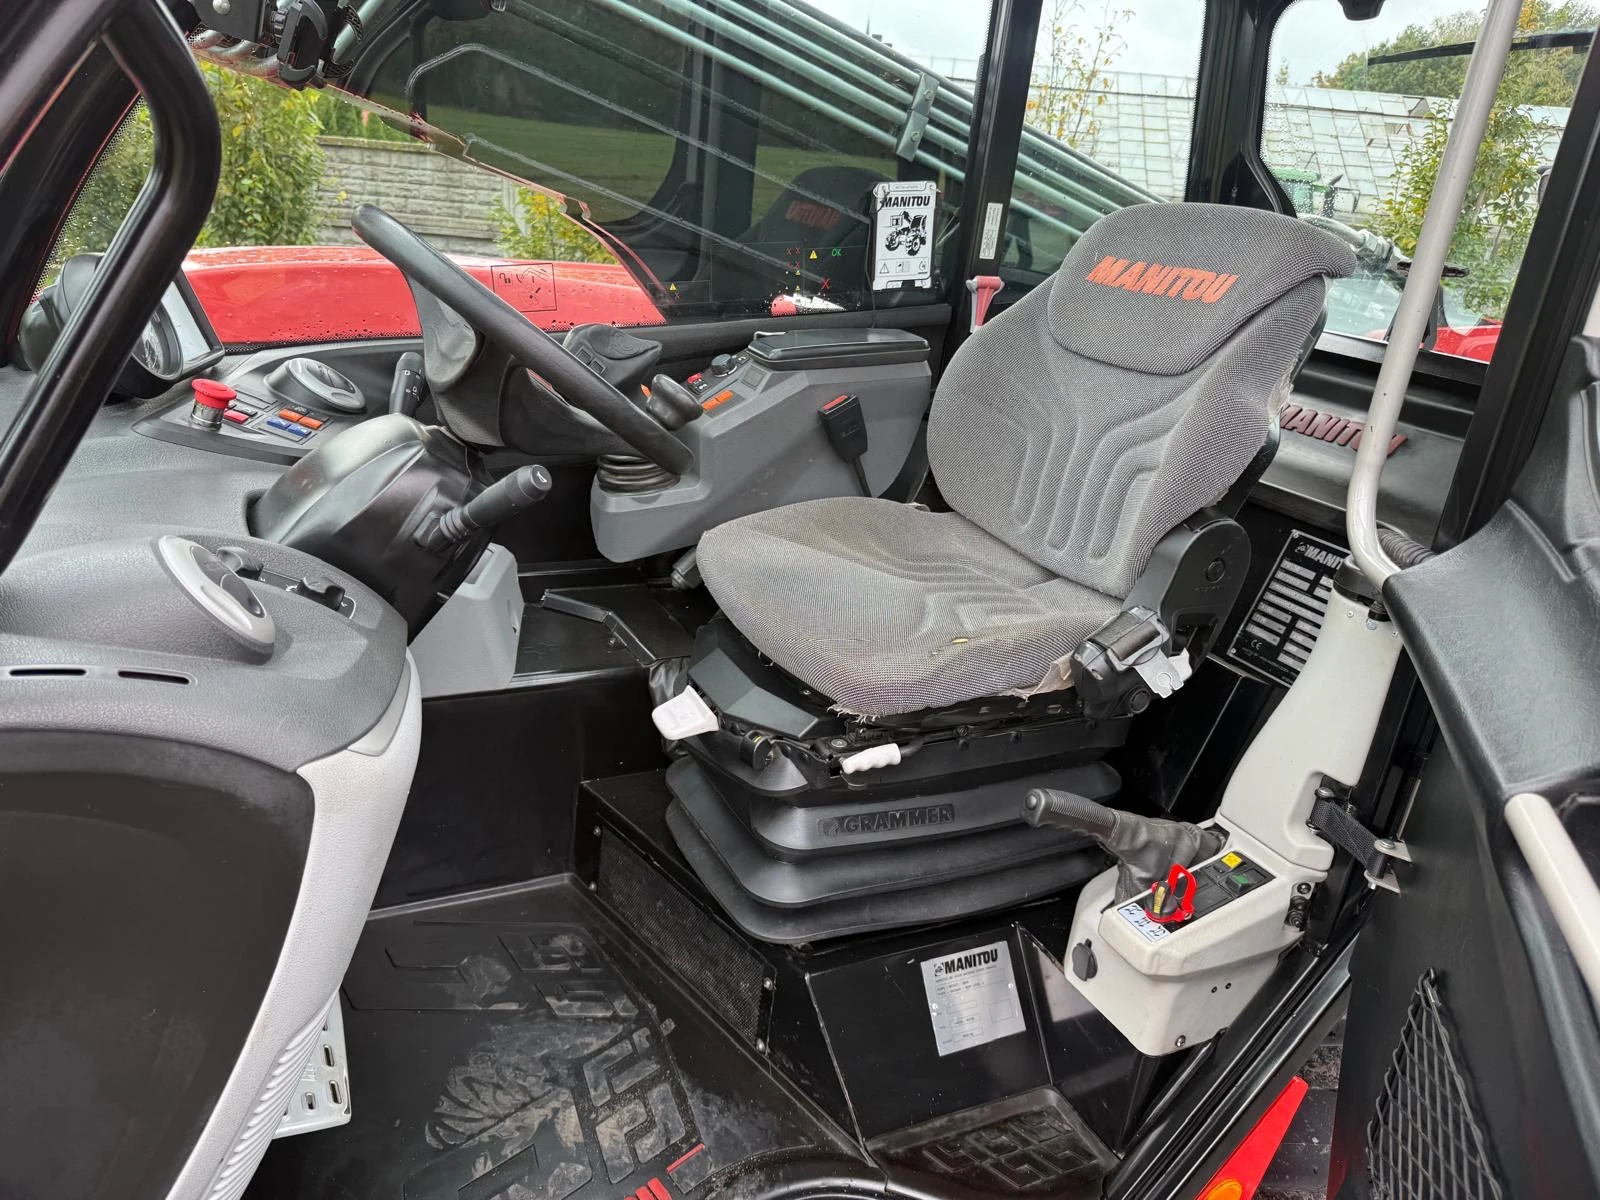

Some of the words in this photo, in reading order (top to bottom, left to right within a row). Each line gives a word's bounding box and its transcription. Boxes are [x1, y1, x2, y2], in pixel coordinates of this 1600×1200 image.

[882, 195, 931, 208] MANITOU
[831, 248, 842, 257] OK
[1085, 255, 1240, 304] MANITOU
[1279, 402, 1408, 457] MANIT
[1250, 639, 1263, 650] CE
[843, 805, 951, 833] GRAMMER
[944, 948, 998, 975] MANITOU
